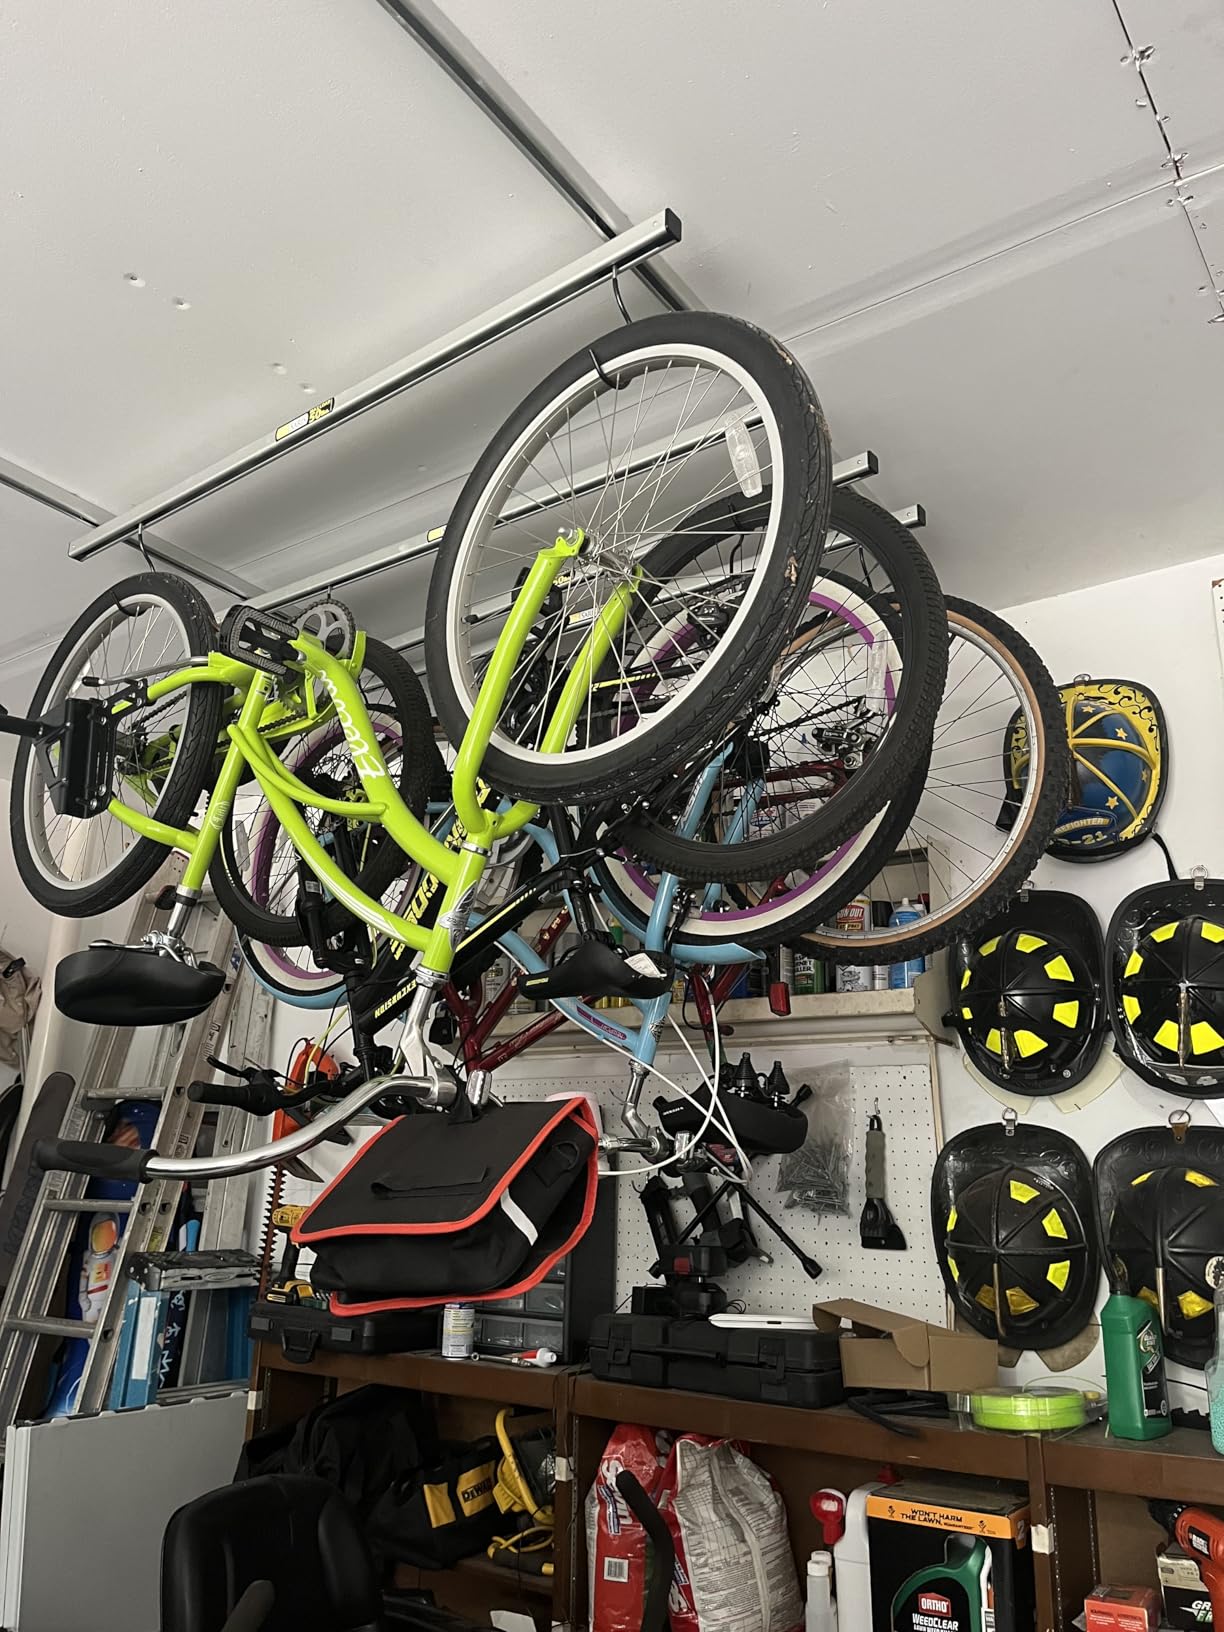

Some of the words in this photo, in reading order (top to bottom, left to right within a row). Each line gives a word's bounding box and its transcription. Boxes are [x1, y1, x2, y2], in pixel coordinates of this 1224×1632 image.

[375, 980, 417, 1019] EXCURSION
[900, 1513, 916, 1521] THE
[911, 1508, 937, 1518] WON'T
[939, 1513, 962, 1523] HARM
[921, 1597, 947, 1613] ORTHO
